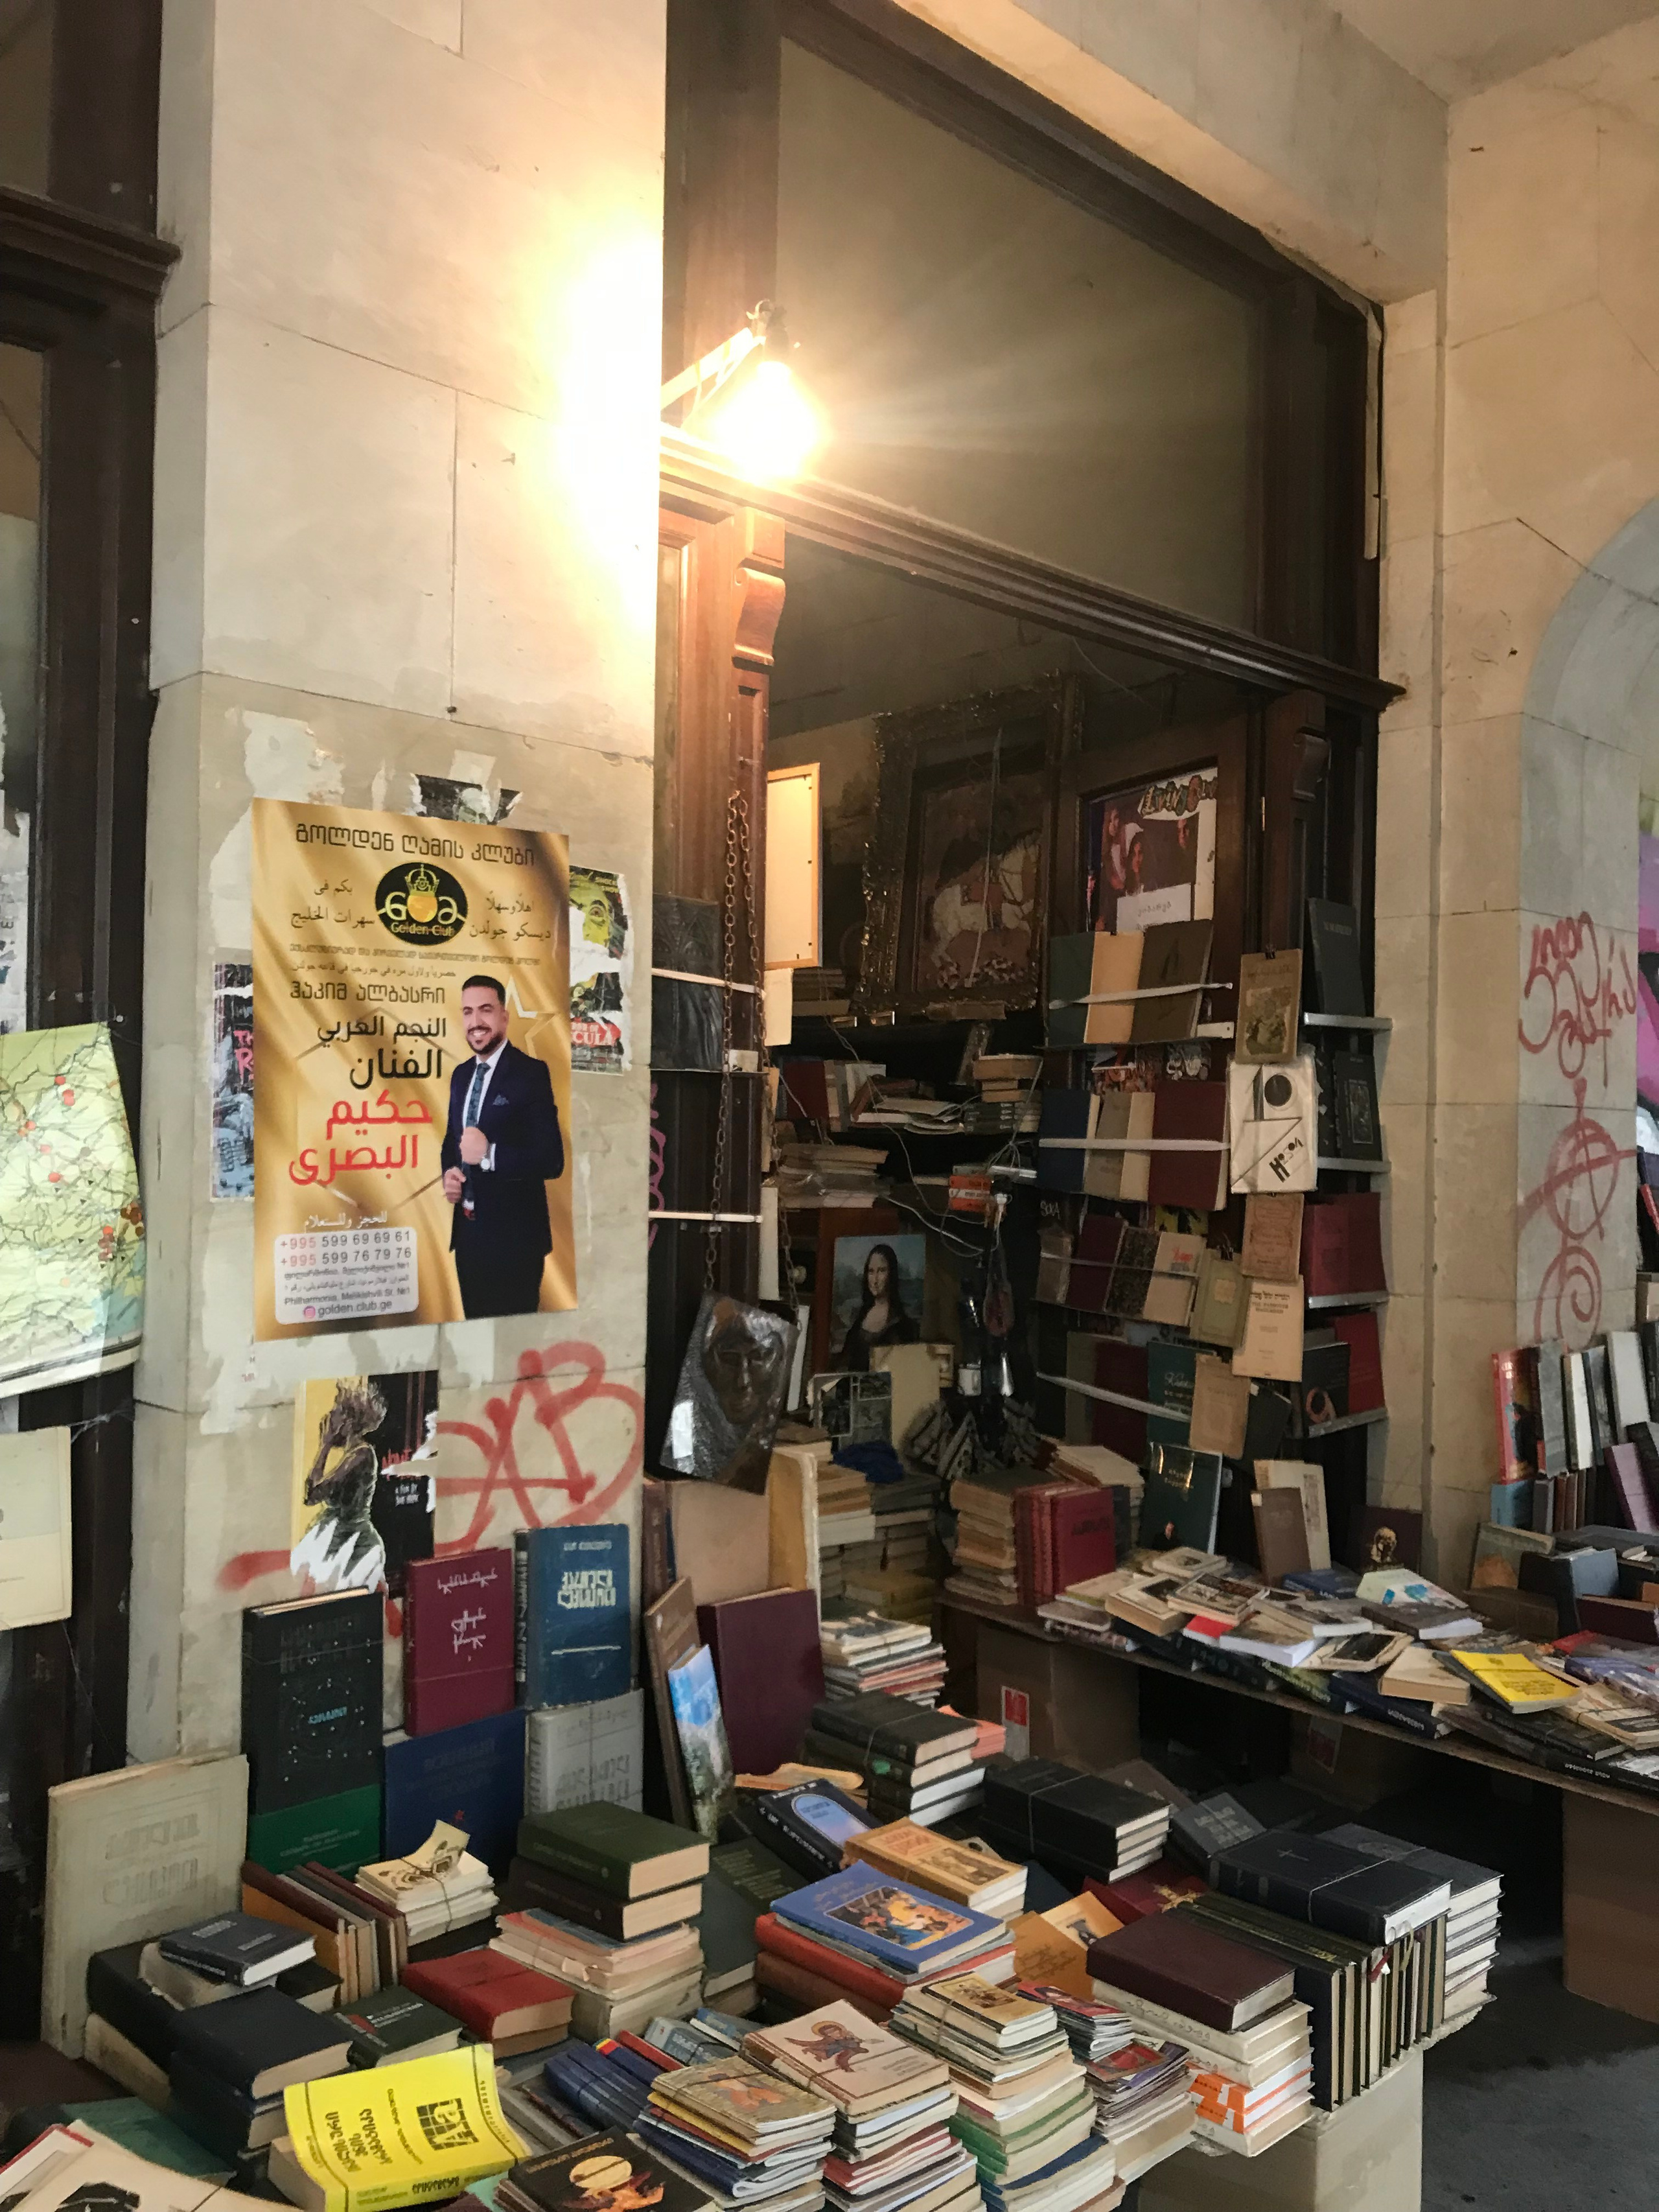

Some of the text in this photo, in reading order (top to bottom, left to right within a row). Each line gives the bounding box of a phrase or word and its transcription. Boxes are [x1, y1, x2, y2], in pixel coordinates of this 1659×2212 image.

[296, 822, 535, 867] გოლდენ ღამის კლუბი
[390, 922, 456, 937] Golden Club
[290, 981, 446, 1005] ჰაკიმ ალბასრი
[317, 1016, 447, 1049] النجم العربي
[350, 1047, 442, 1091] الفنان
[326, 1089, 434, 1141] حكيم
[357, 1211, 388, 1229] للحجز
[281, 1231, 410, 1250] +995 599 69 69 61
[281, 1247, 412, 1267] +995 599 76 79 76
